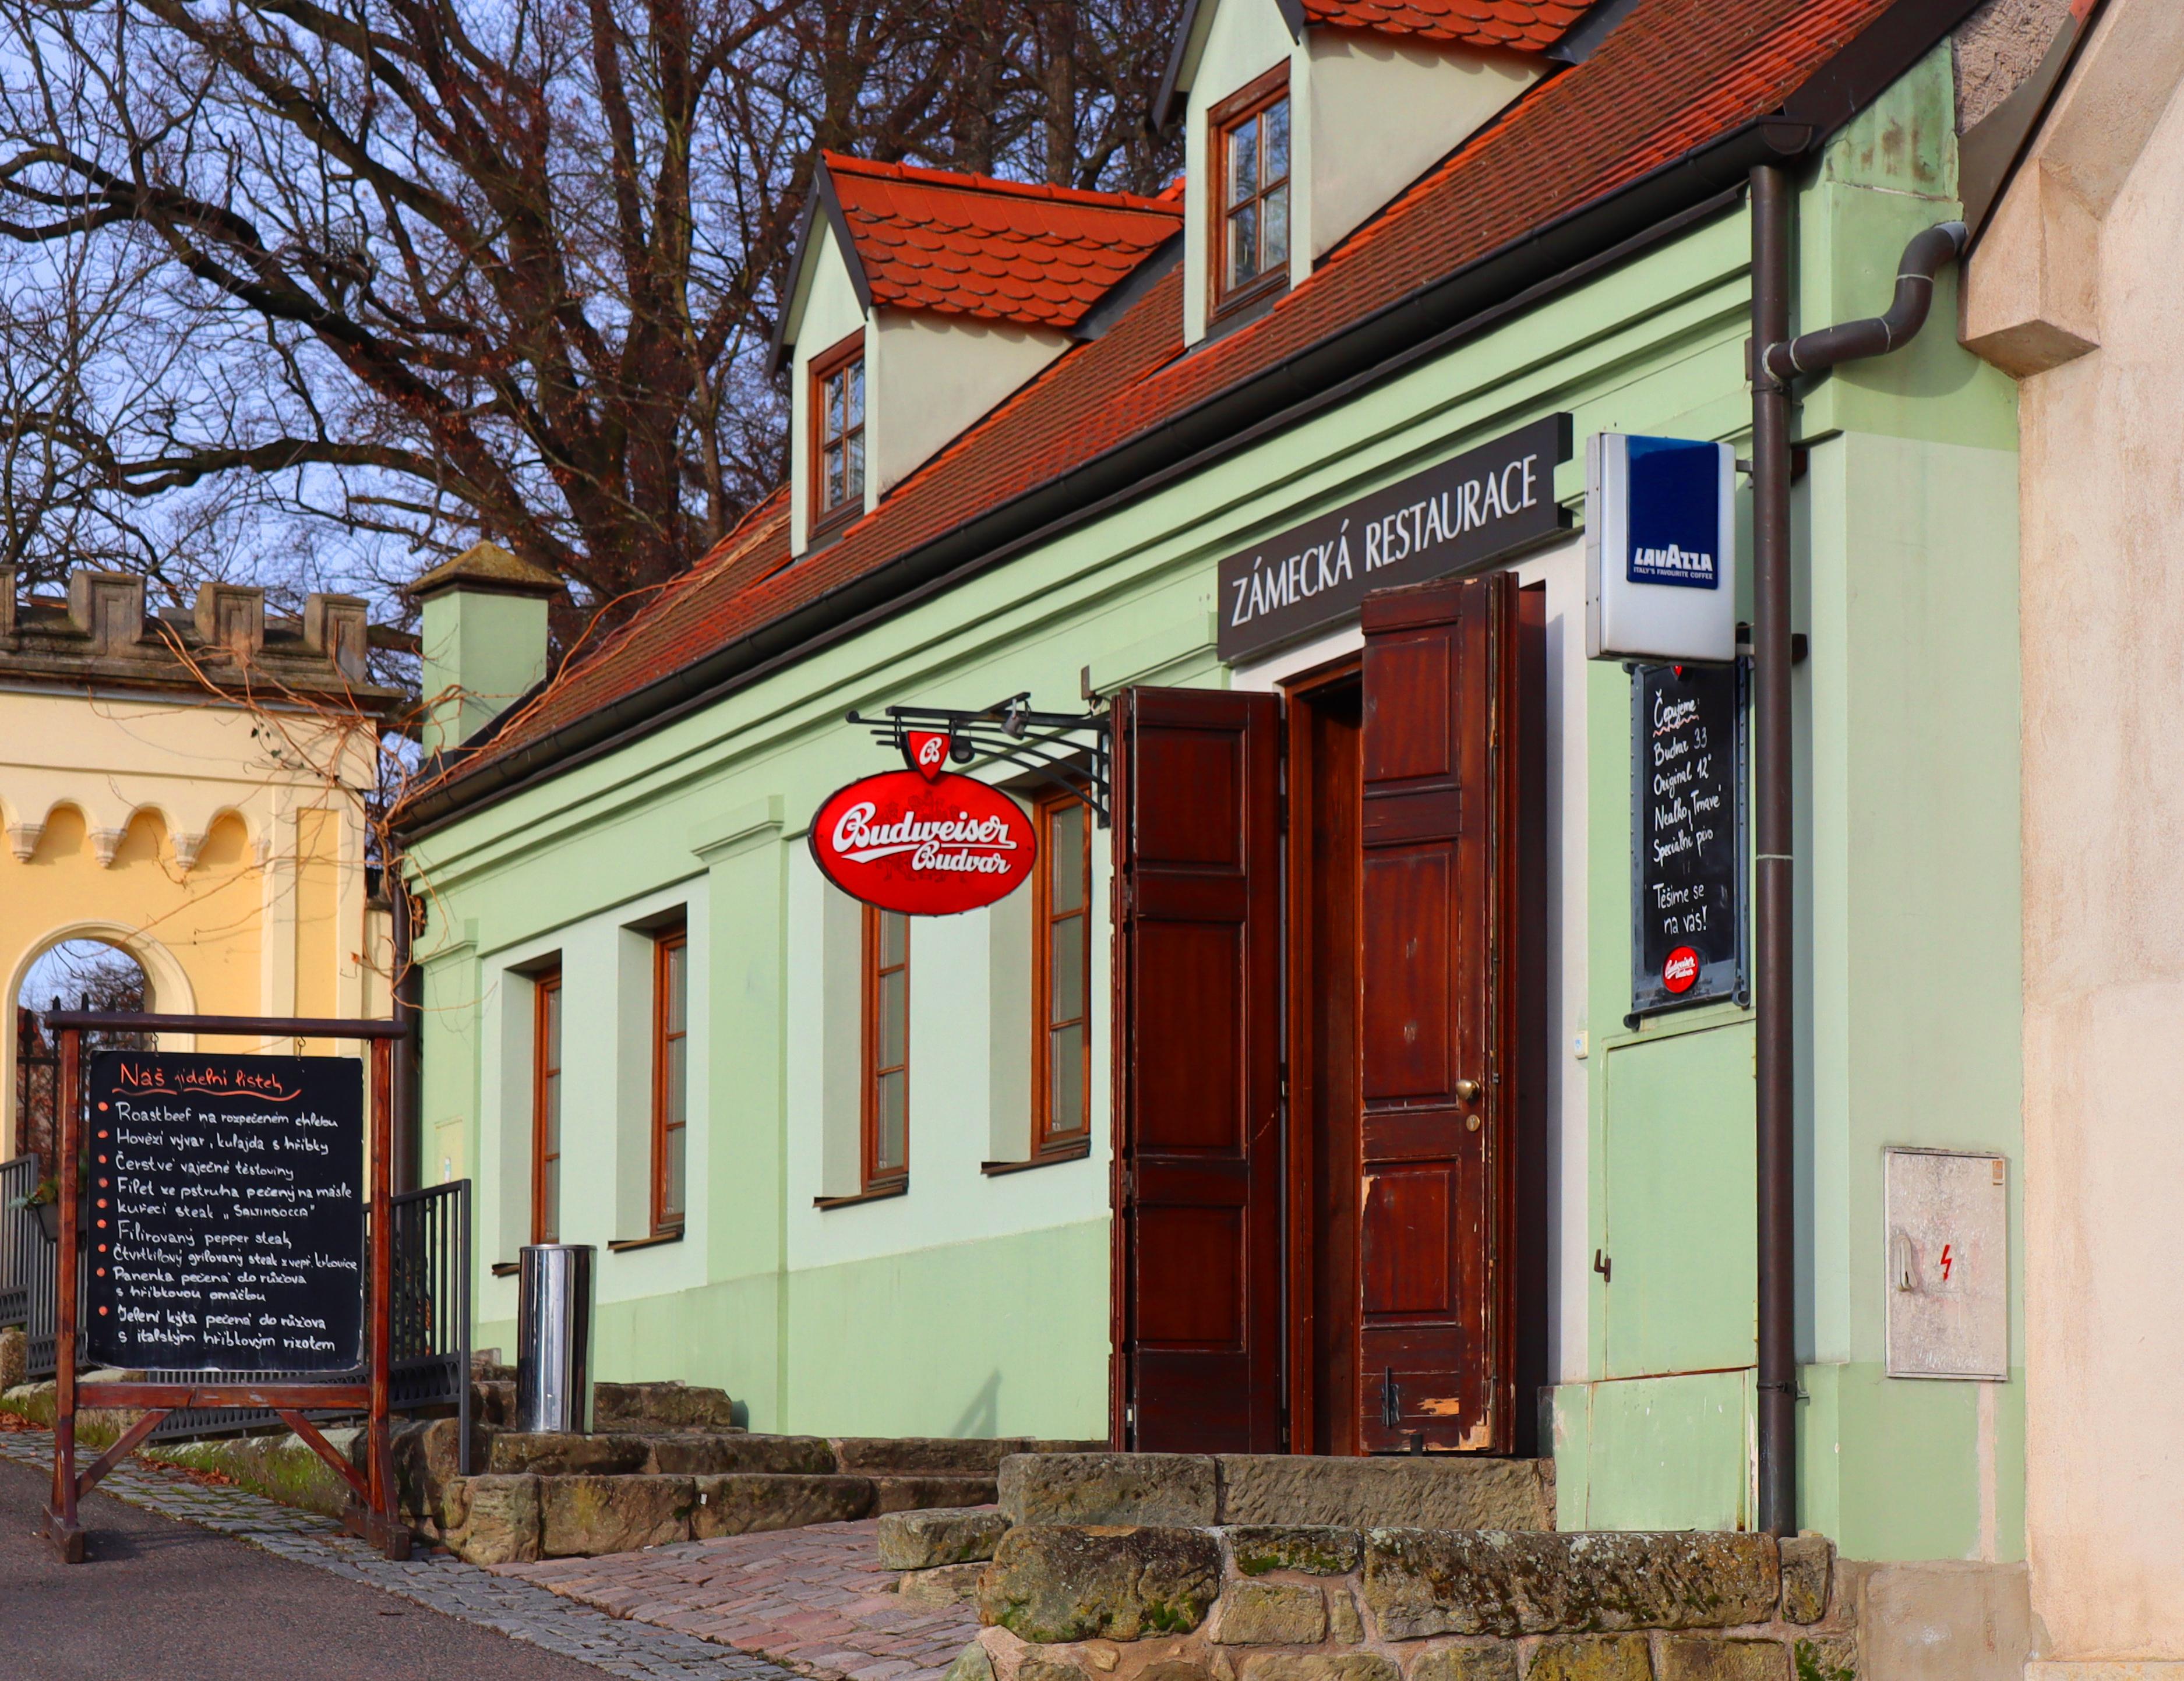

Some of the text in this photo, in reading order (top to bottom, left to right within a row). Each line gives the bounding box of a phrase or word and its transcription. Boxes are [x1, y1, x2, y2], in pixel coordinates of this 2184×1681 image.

[1231, 454, 1537, 627] ZÁMECKÁ RESTAURACE
[1633, 544, 1713, 571] LAVAZZA
[1633, 566, 1655, 575] ITALY'S
[1657, 568, 1689, 578] FAVOURITE
[1693, 726, 1707, 750] 33
[919, 737, 943, 765] B
[832, 801, 1017, 853] Budweiser
[1696, 825, 1713, 857] pivo
[912, 841, 1011, 874] Budvar
[1693, 884, 1705, 900] se
[1664, 905, 1707, 935] na vás!
[121, 1062, 165, 1087] Náš
[199, 1112, 218, 1125] na
[217, 1132, 265, 1153] kulajda
[273, 1139, 280, 1151] s
[115, 1150, 175, 1172] Čerstvé
[117, 1176, 352, 1203] Filet ze pstruha pečený na másle
[175, 1203, 214, 1219] steak
[204, 1233, 250, 1246] pepper
[255, 1230, 292, 1249] steak
[248, 1252, 278, 1266] steak
[112, 1265, 175, 1282] Panenka
[181, 1272, 232, 1286] pečená
[237, 1272, 257, 1283] do
[116, 1287, 124, 1297] s
[205, 1312, 252, 1329] pečená
[259, 1313, 277, 1325] do
[118, 1330, 128, 1343] s
[137, 1327, 196, 1346] italským
[283, 1334, 336, 1352] rizotem
